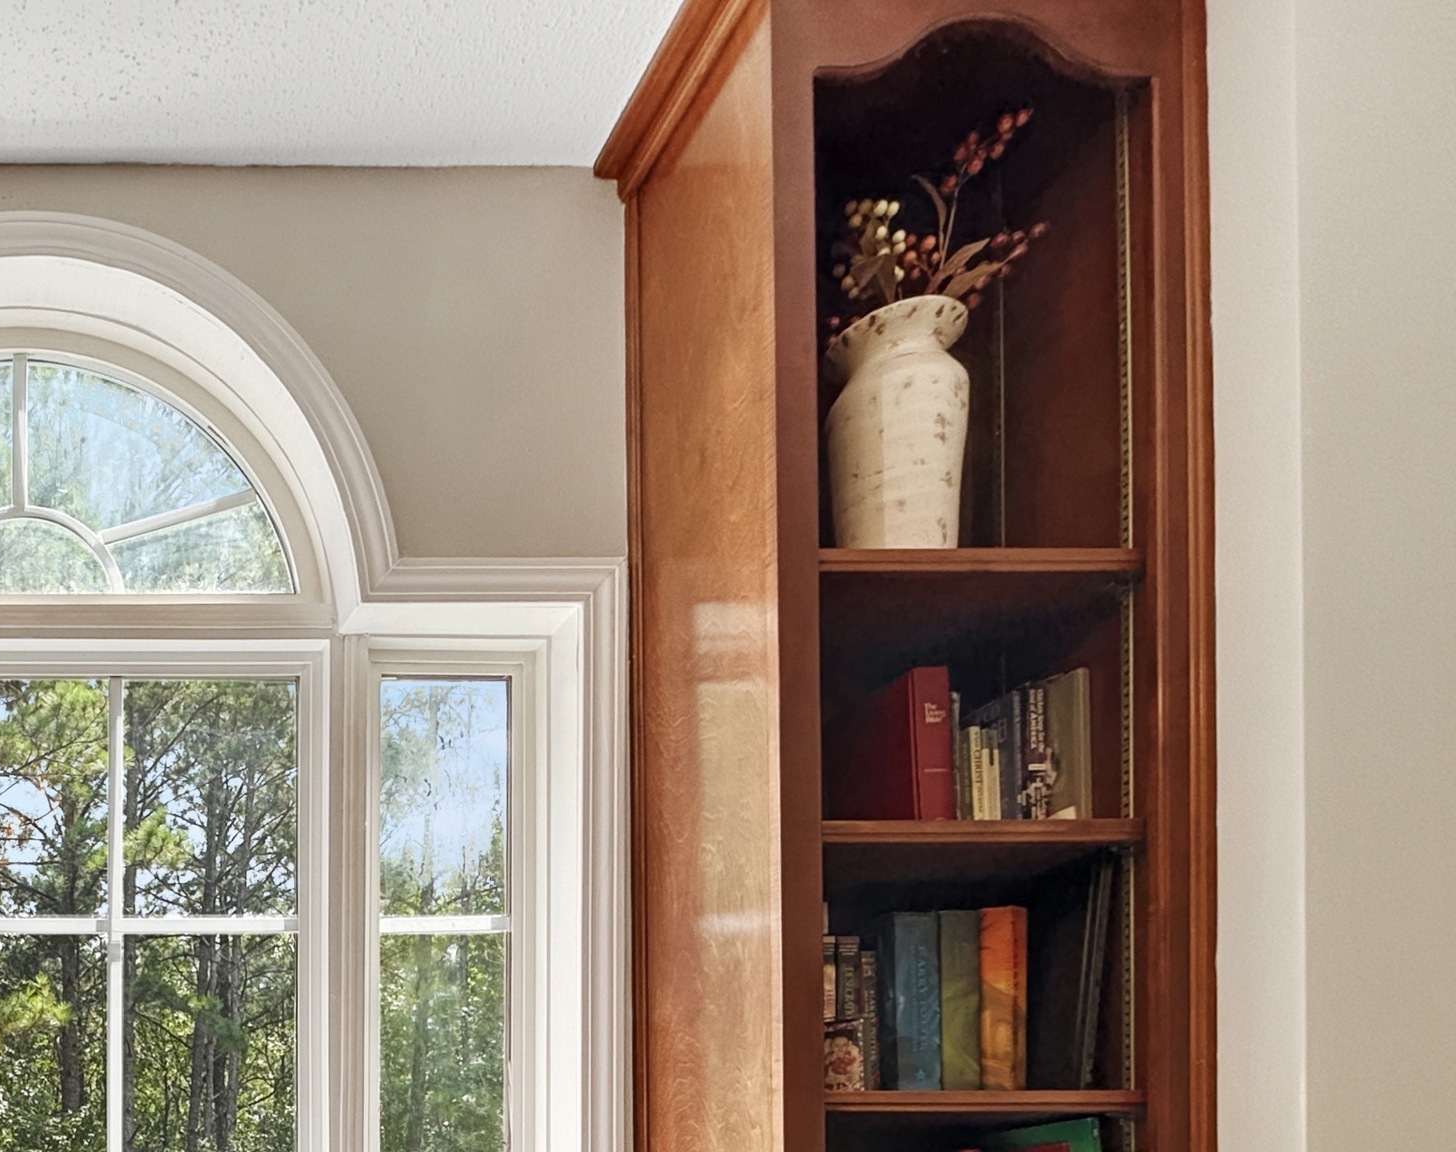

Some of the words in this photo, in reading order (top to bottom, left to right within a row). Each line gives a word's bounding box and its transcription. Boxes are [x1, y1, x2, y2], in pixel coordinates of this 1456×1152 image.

[974, 750, 983, 784] CHRIST
[918, 945, 928, 993] HARRY
[920, 1001, 928, 1050] POTTER
